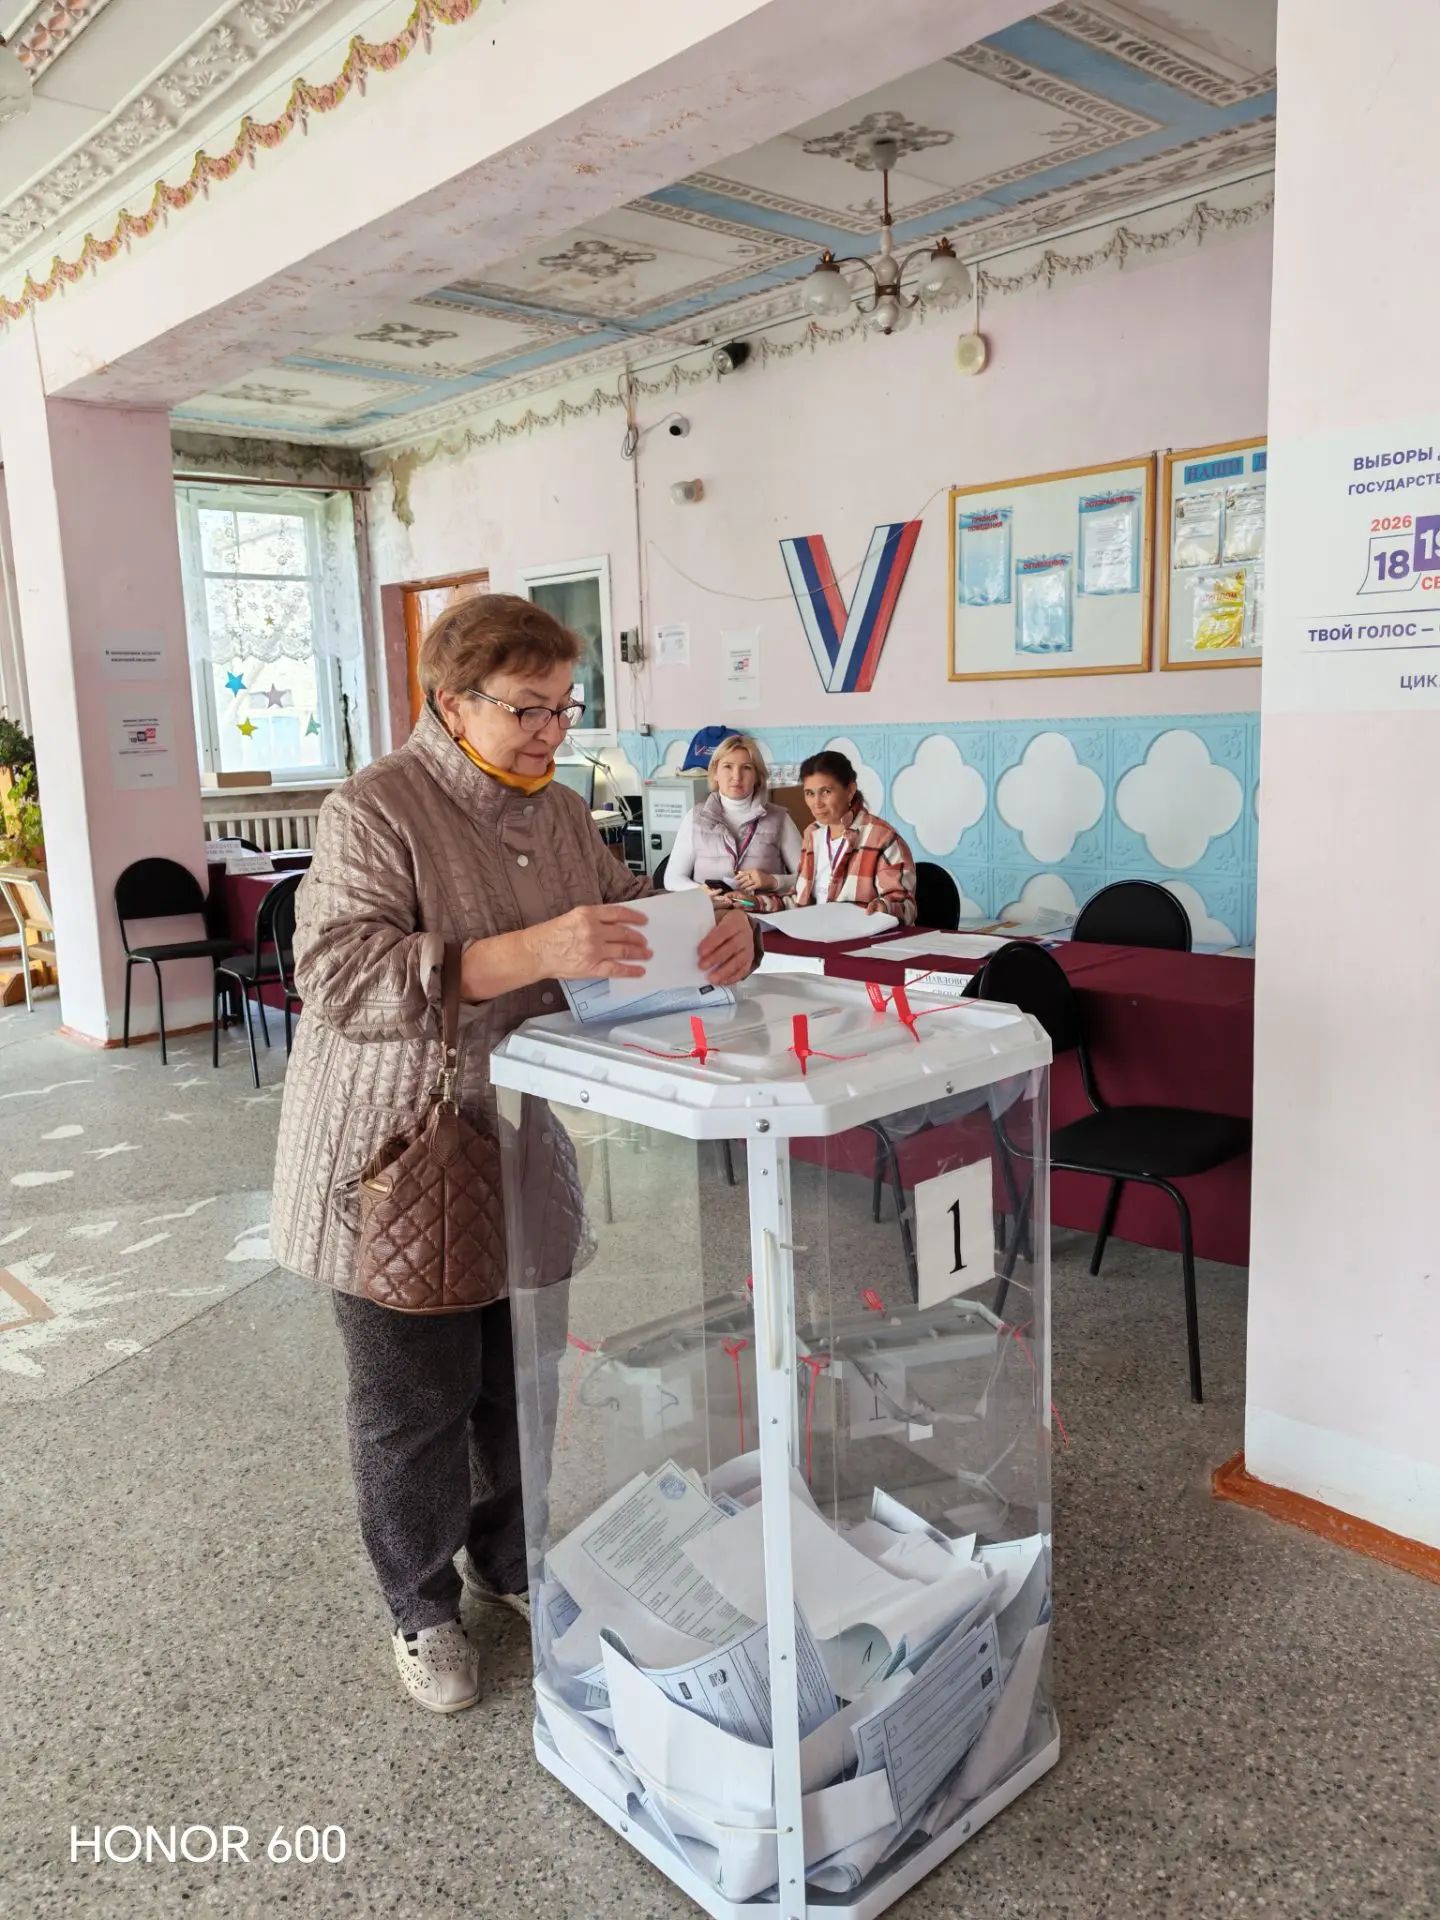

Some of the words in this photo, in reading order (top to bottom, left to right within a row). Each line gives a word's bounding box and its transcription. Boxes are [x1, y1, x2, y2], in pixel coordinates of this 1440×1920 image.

[1353, 447, 1433, 471] ВЫБОРЫ
[1371, 515, 1413, 532] 2026
[1373, 549, 1410, 581] 18
[1308, 623, 1353, 642] ТВОЙ
[1358, 623, 1417, 640] ГОЛОС
[947, 1199, 967, 1274] 1
